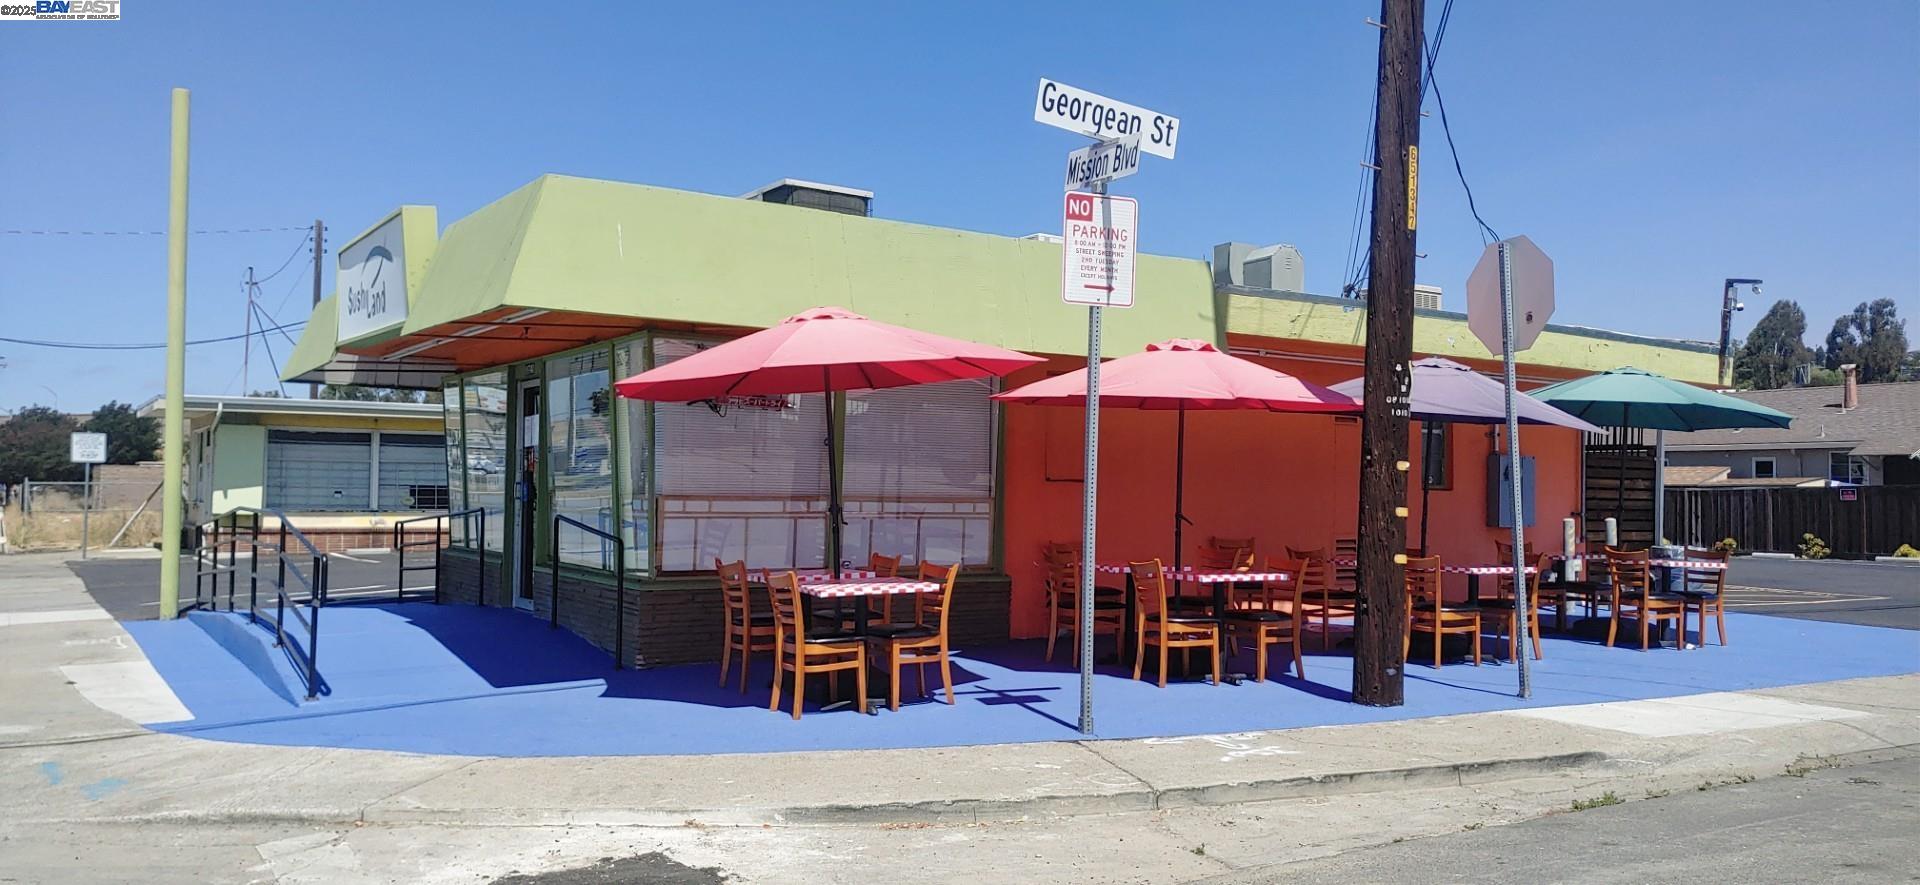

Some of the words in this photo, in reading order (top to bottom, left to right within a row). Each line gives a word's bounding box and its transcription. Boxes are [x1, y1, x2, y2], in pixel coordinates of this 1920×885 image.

[1042, 82, 1142, 136] Georgean
[1150, 115, 1174, 147] St
[1066, 151, 1109, 185] Mission
[1112, 140, 1139, 173] Blvd
[1069, 199, 1091, 216] NO
[1072, 224, 1128, 242] PARKING
[1076, 248, 1096, 256] STREET
[1097, 249, 1125, 258] SWEEPING
[1095, 258, 1120, 266] TUESDAY
[366, 281, 386, 319] Land
